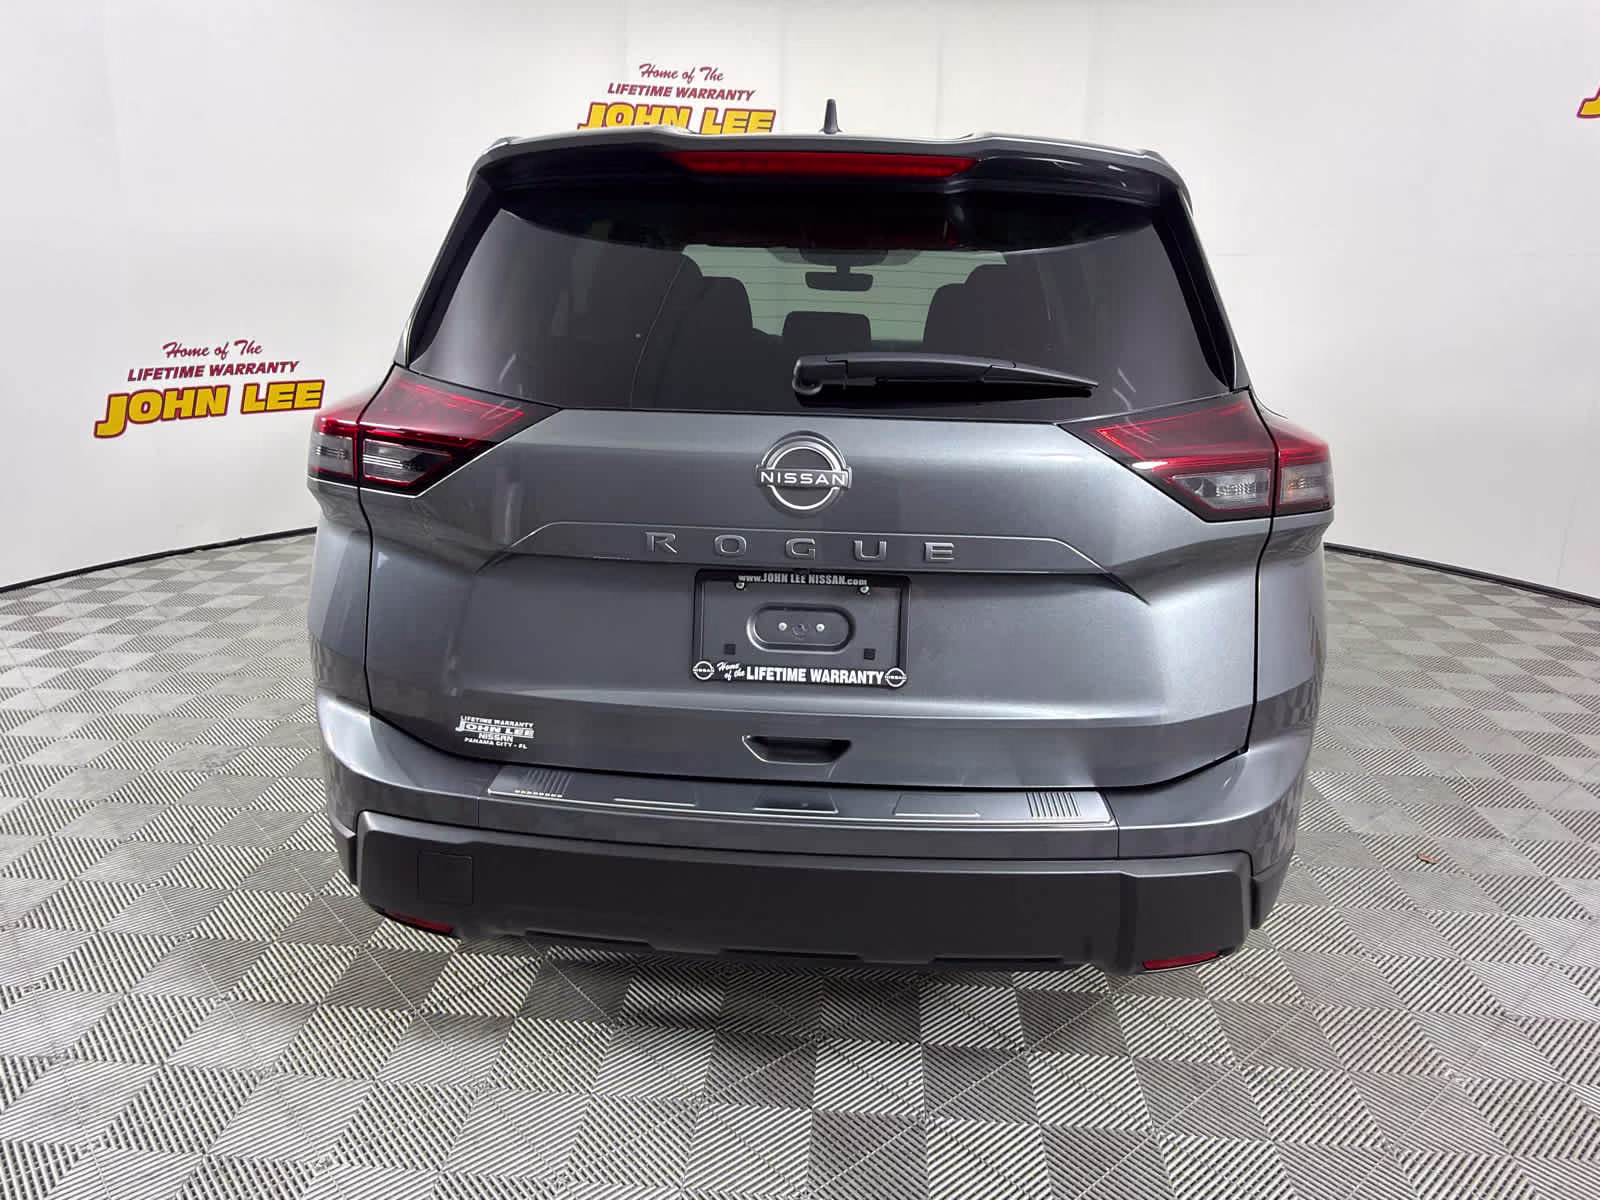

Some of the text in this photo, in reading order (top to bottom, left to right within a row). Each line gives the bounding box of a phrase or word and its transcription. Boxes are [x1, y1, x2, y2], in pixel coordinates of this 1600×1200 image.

[639, 63, 725, 83] Home of The
[607, 83, 757, 101] LIFETIME WARRANTY
[577, 101, 776, 134] JOHN LEE
[162, 339, 263, 359] Home of The
[127, 361, 300, 381] LIFETIME WARRANTY
[94, 380, 325, 438] JOHN LEE
[760, 469, 846, 486] NISSAN
[644, 531, 956, 562] ROGUE
[746, 666, 885, 685] LIFETIME WARRANTY
[478, 732, 513, 742] NISSAN
